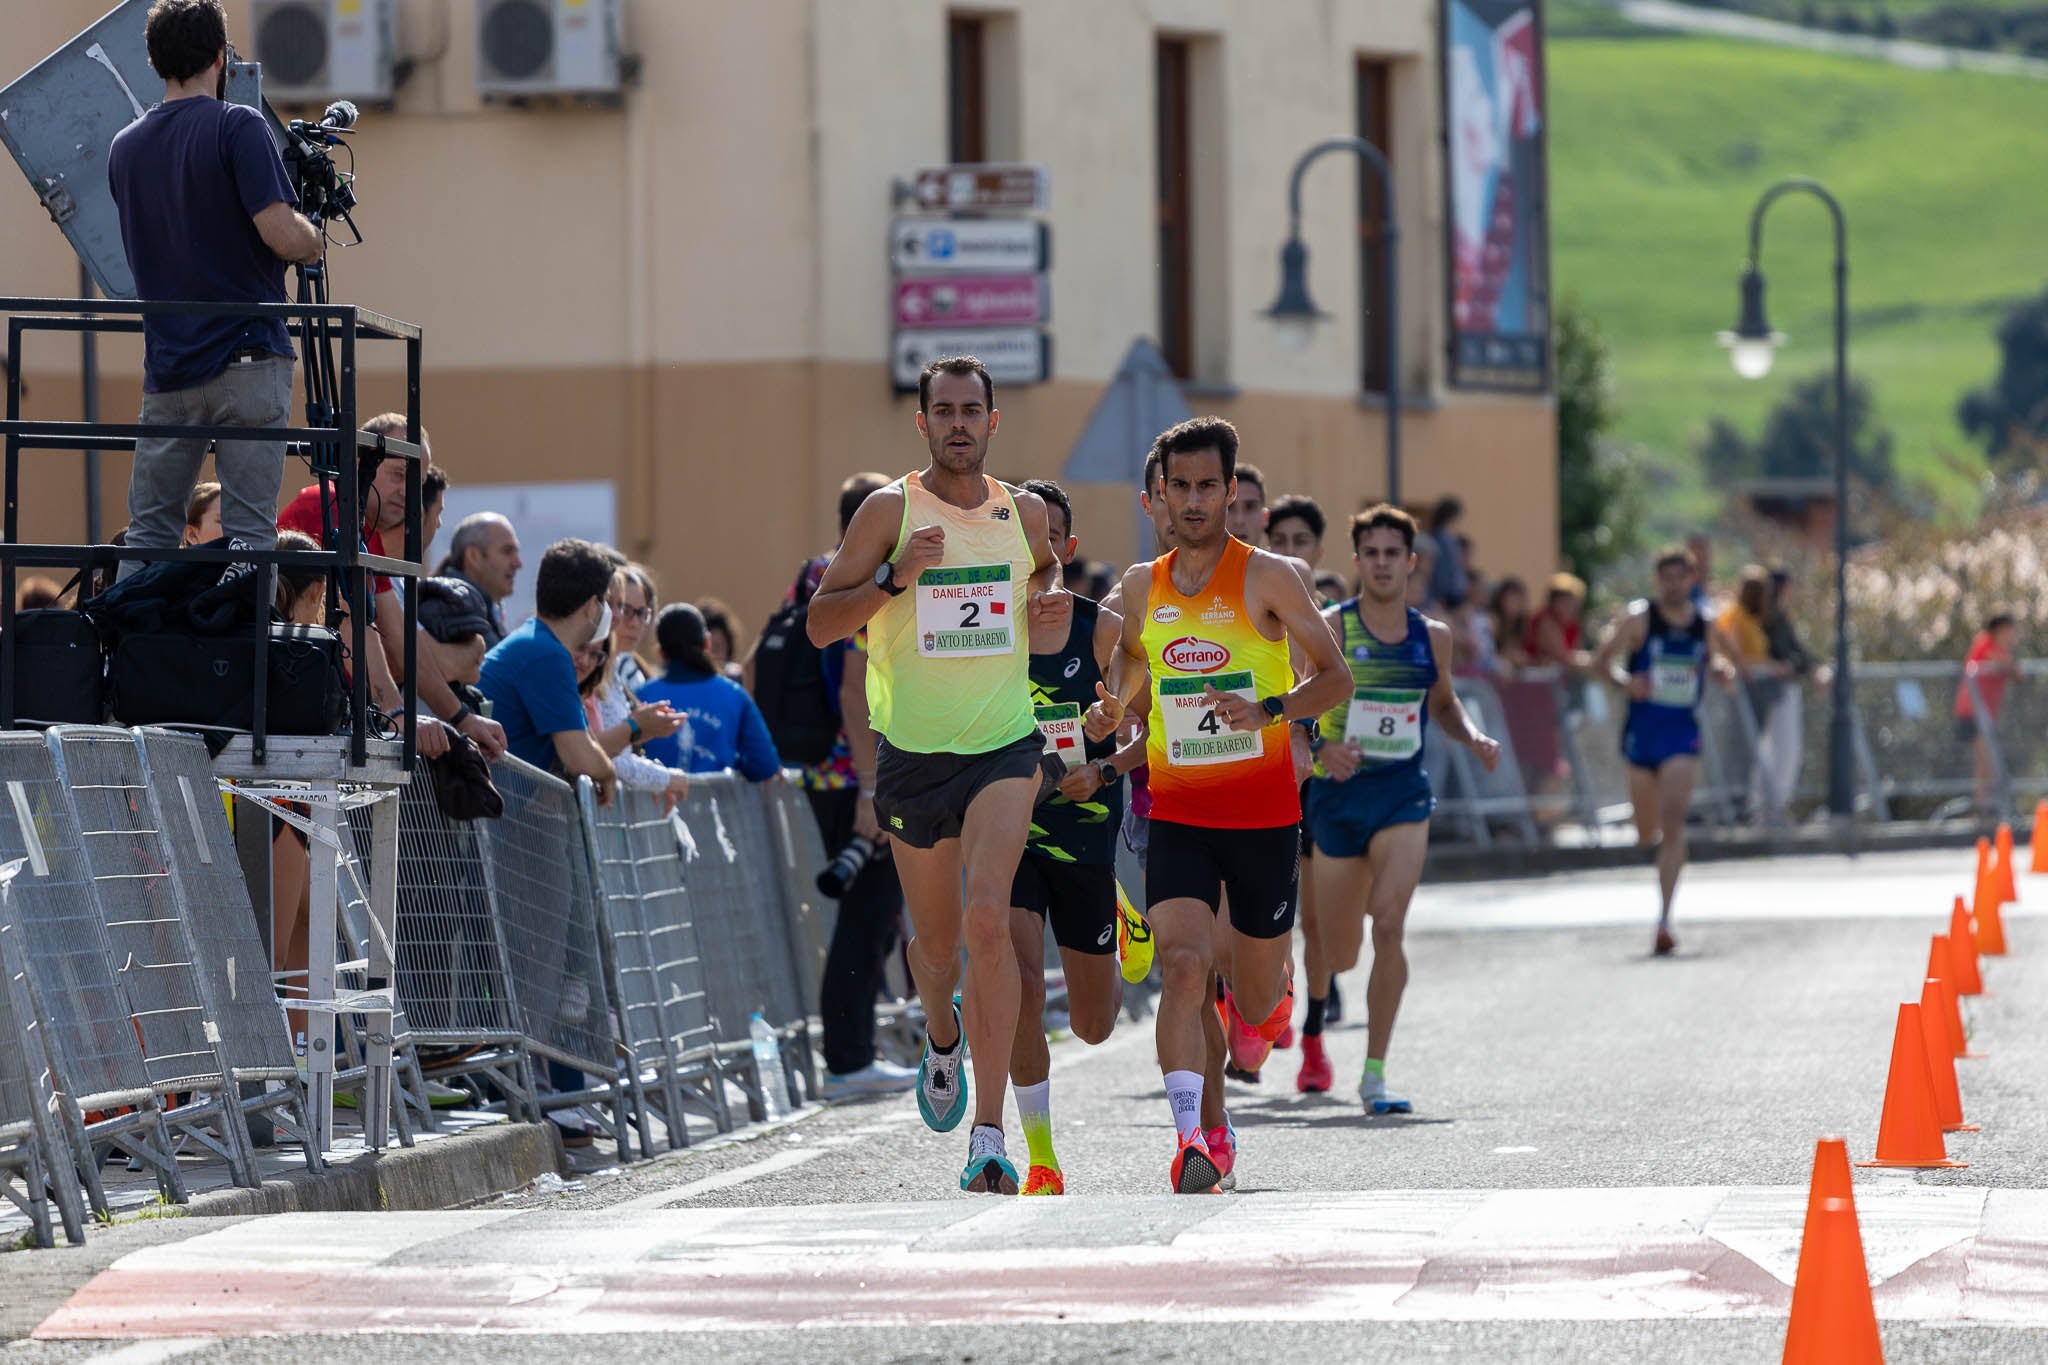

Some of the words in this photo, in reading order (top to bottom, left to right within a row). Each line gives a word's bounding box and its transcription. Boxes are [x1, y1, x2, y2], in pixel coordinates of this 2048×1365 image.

[922, 571, 960, 585] COSTA
[968, 569, 980, 584] DE
[986, 568, 1006, 582] AJO
[932, 587, 969, 599] DANIEL
[970, 585, 994, 598] ARCE
[959, 602, 980, 628] 2
[1155, 610, 1180, 620] Serrano
[1201, 610, 1235, 620] SERRANO
[936, 634, 960, 648] AYTO
[961, 633, 974, 648] DE
[975, 631, 1006, 647] BAREYO
[1169, 647, 1224, 665] Serrano
[1197, 709, 1220, 735] 4
[1378, 716, 1395, 736] 8
[1182, 742, 1202, 756] AYTO
[1203, 741, 1215, 755] DE
[1216, 736, 1253, 754] BAREYO
